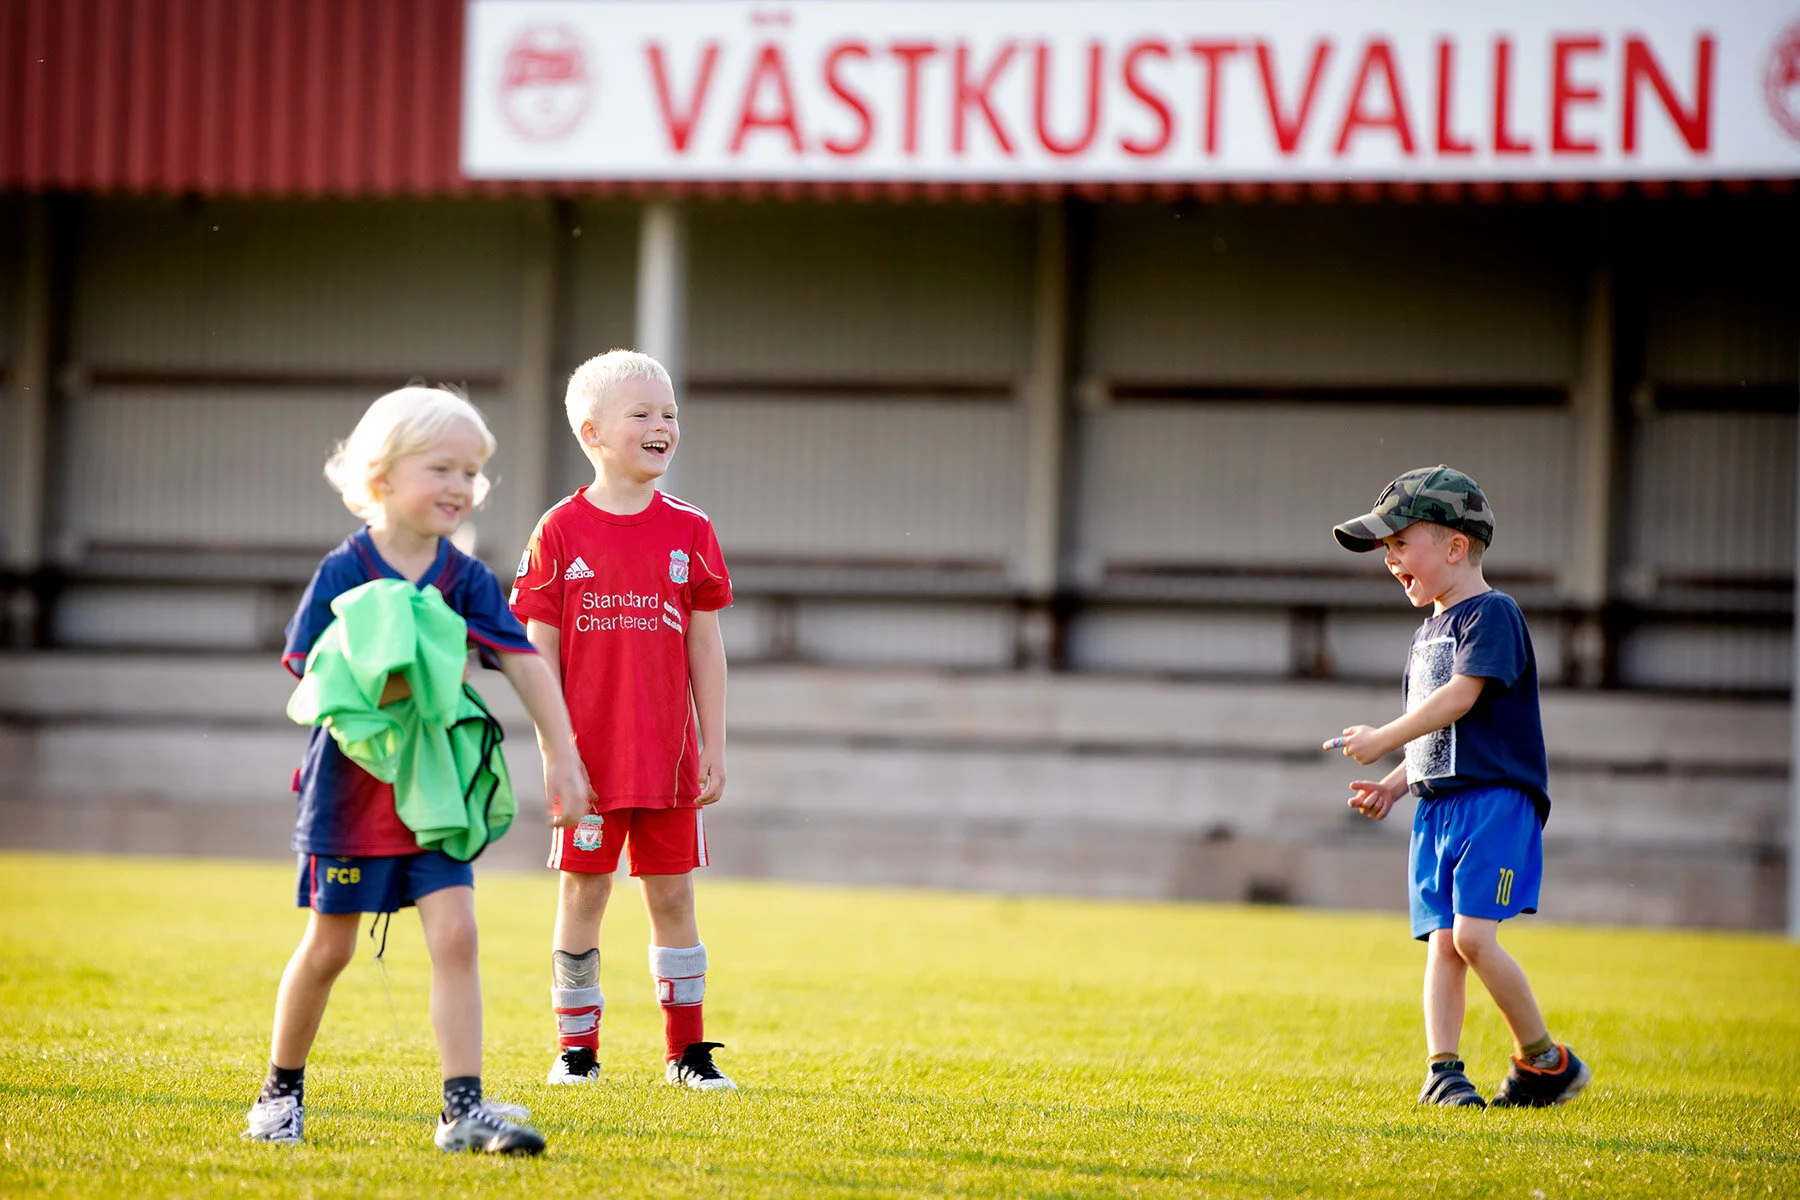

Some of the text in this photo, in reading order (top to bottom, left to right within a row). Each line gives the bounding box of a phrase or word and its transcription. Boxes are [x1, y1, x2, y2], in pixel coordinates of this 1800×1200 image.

[643, 10, 1717, 156] VÄSTKUSTVALLEN
[564, 570, 594, 580] adidas
[582, 590, 658, 610] Standard
[576, 614, 658, 632] Chartered
[326, 867, 361, 885] FCB
[1495, 867, 1514, 906] 10
